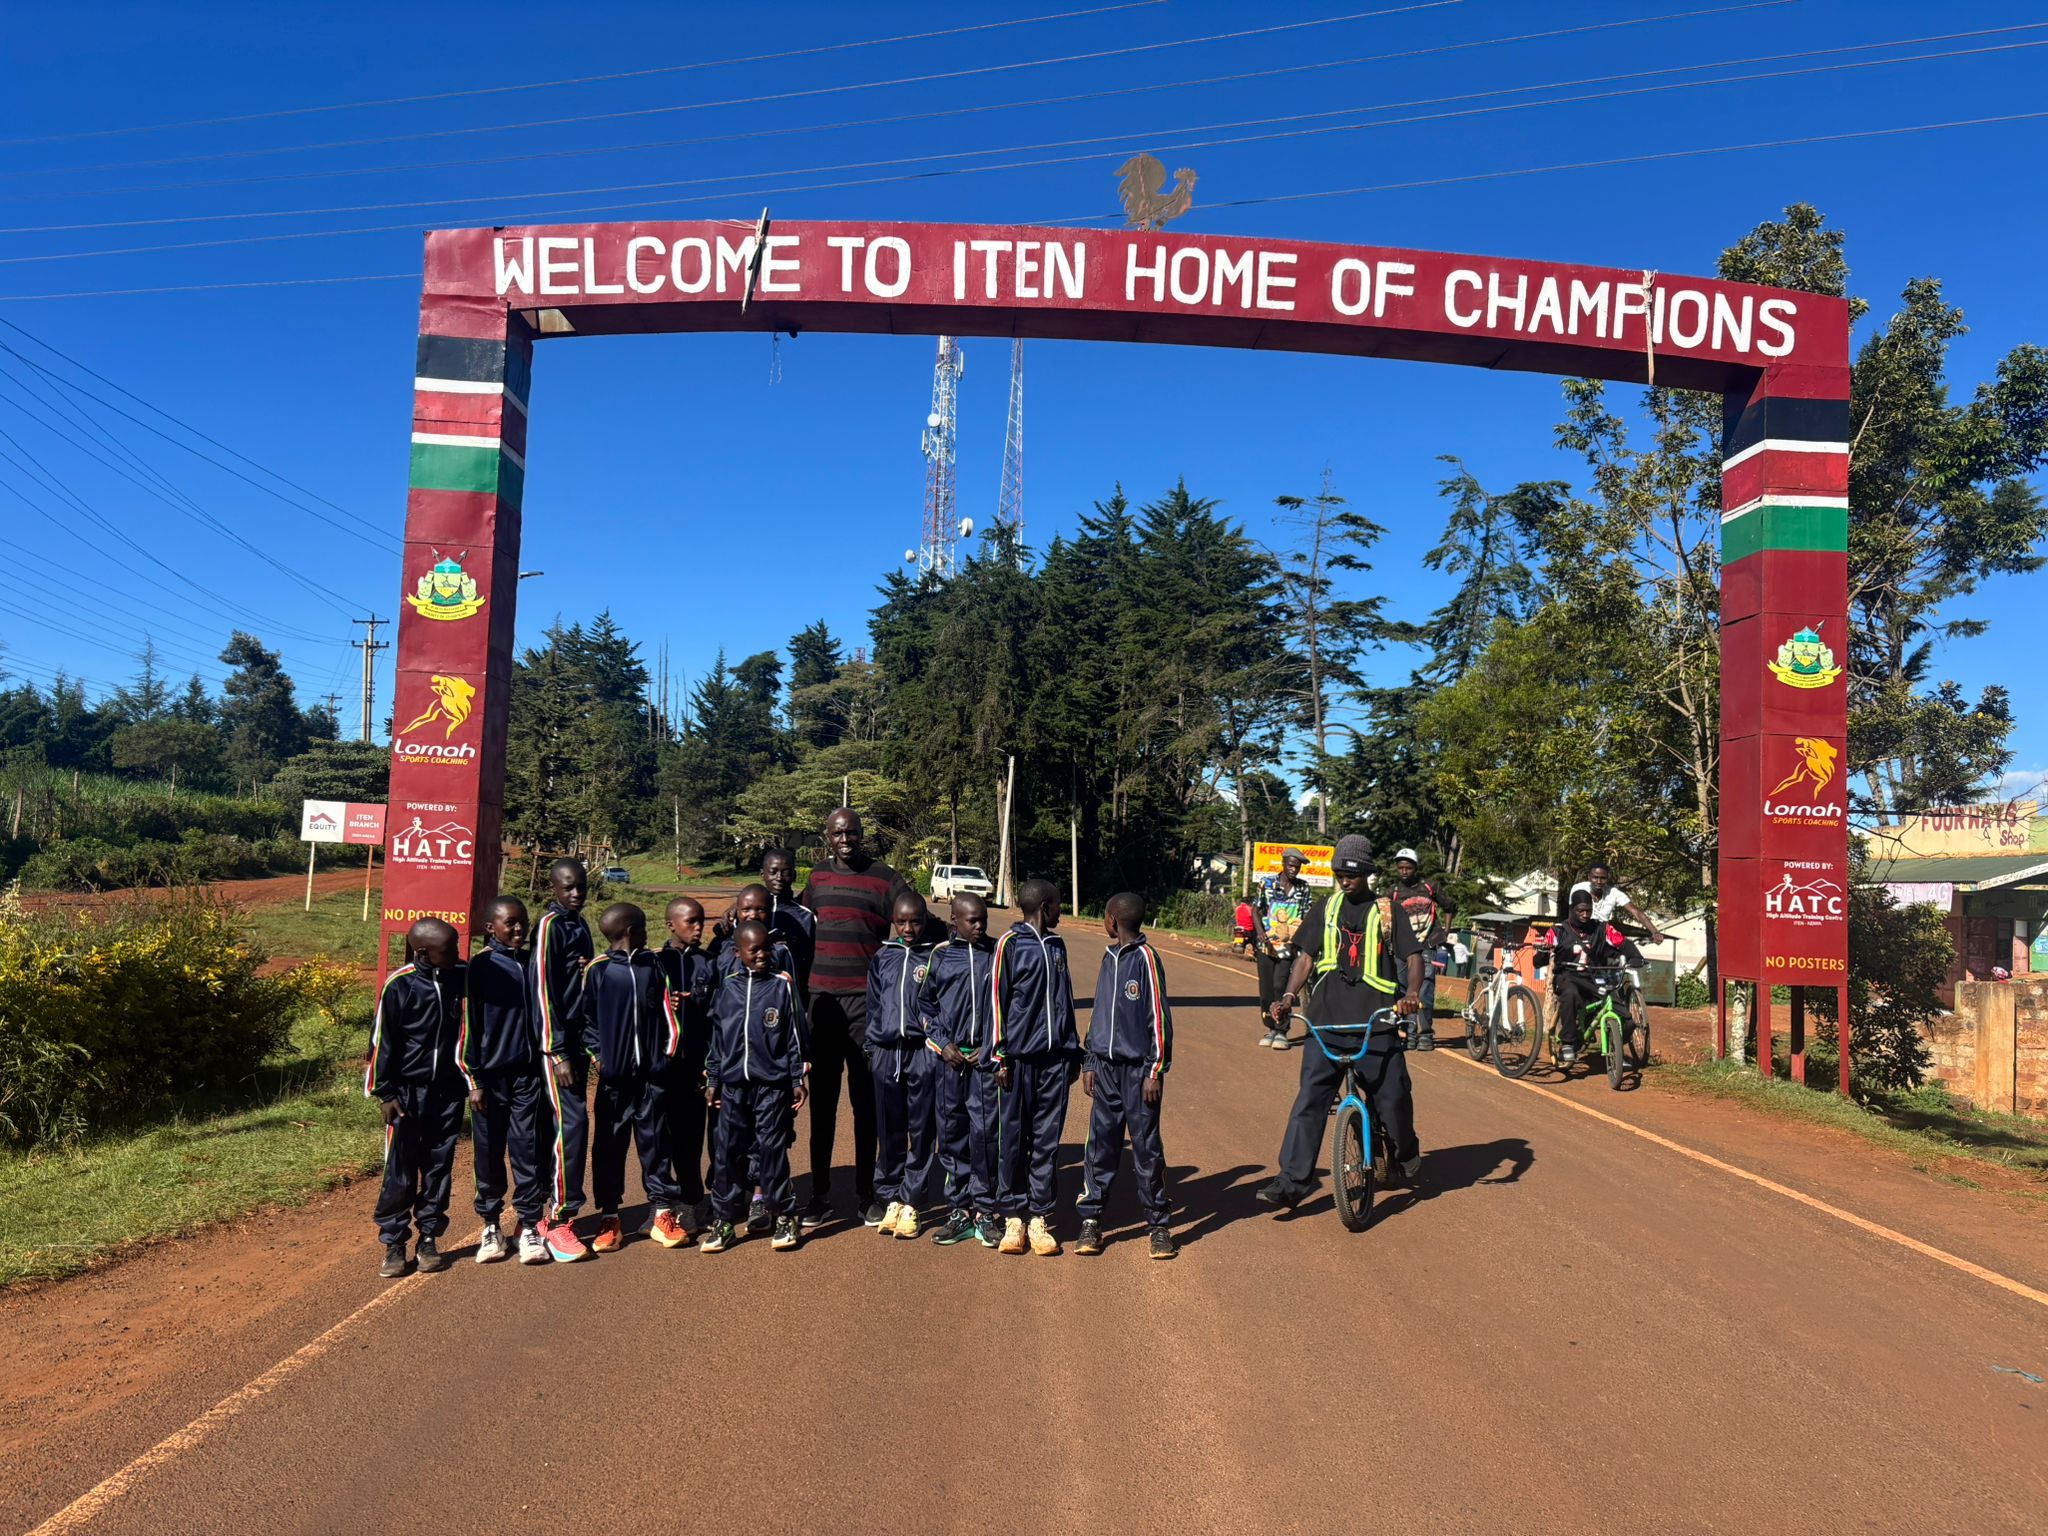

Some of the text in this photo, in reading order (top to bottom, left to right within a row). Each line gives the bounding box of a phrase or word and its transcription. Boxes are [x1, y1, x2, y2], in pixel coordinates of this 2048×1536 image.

[493, 235, 1798, 358] WELCOME TO ITEN HOME OF CHAMPIONS
[394, 738, 476, 759] Lornah
[399, 755, 469, 766] SPORTS COACHING
[407, 802, 457, 812] POWERED BY:
[1763, 799, 1842, 818] Lornah
[349, 820, 380, 829] BRANCH
[356, 813, 374, 821] ITEN
[1772, 816, 1839, 827] SPORTS COACHING
[309, 823, 338, 831] EQUITY
[2000, 829, 2025, 848] Shop
[392, 838, 472, 859] HATC
[392, 856, 406, 864] High
[429, 858, 452, 866] Training
[1784, 861, 1834, 871] POWERED BY:
[1927, 883, 1949, 901] 4G
[1765, 894, 1842, 915] HATC
[384, 908, 466, 924] NO POSTERS
[1765, 956, 1845, 971] NO POSTERS
